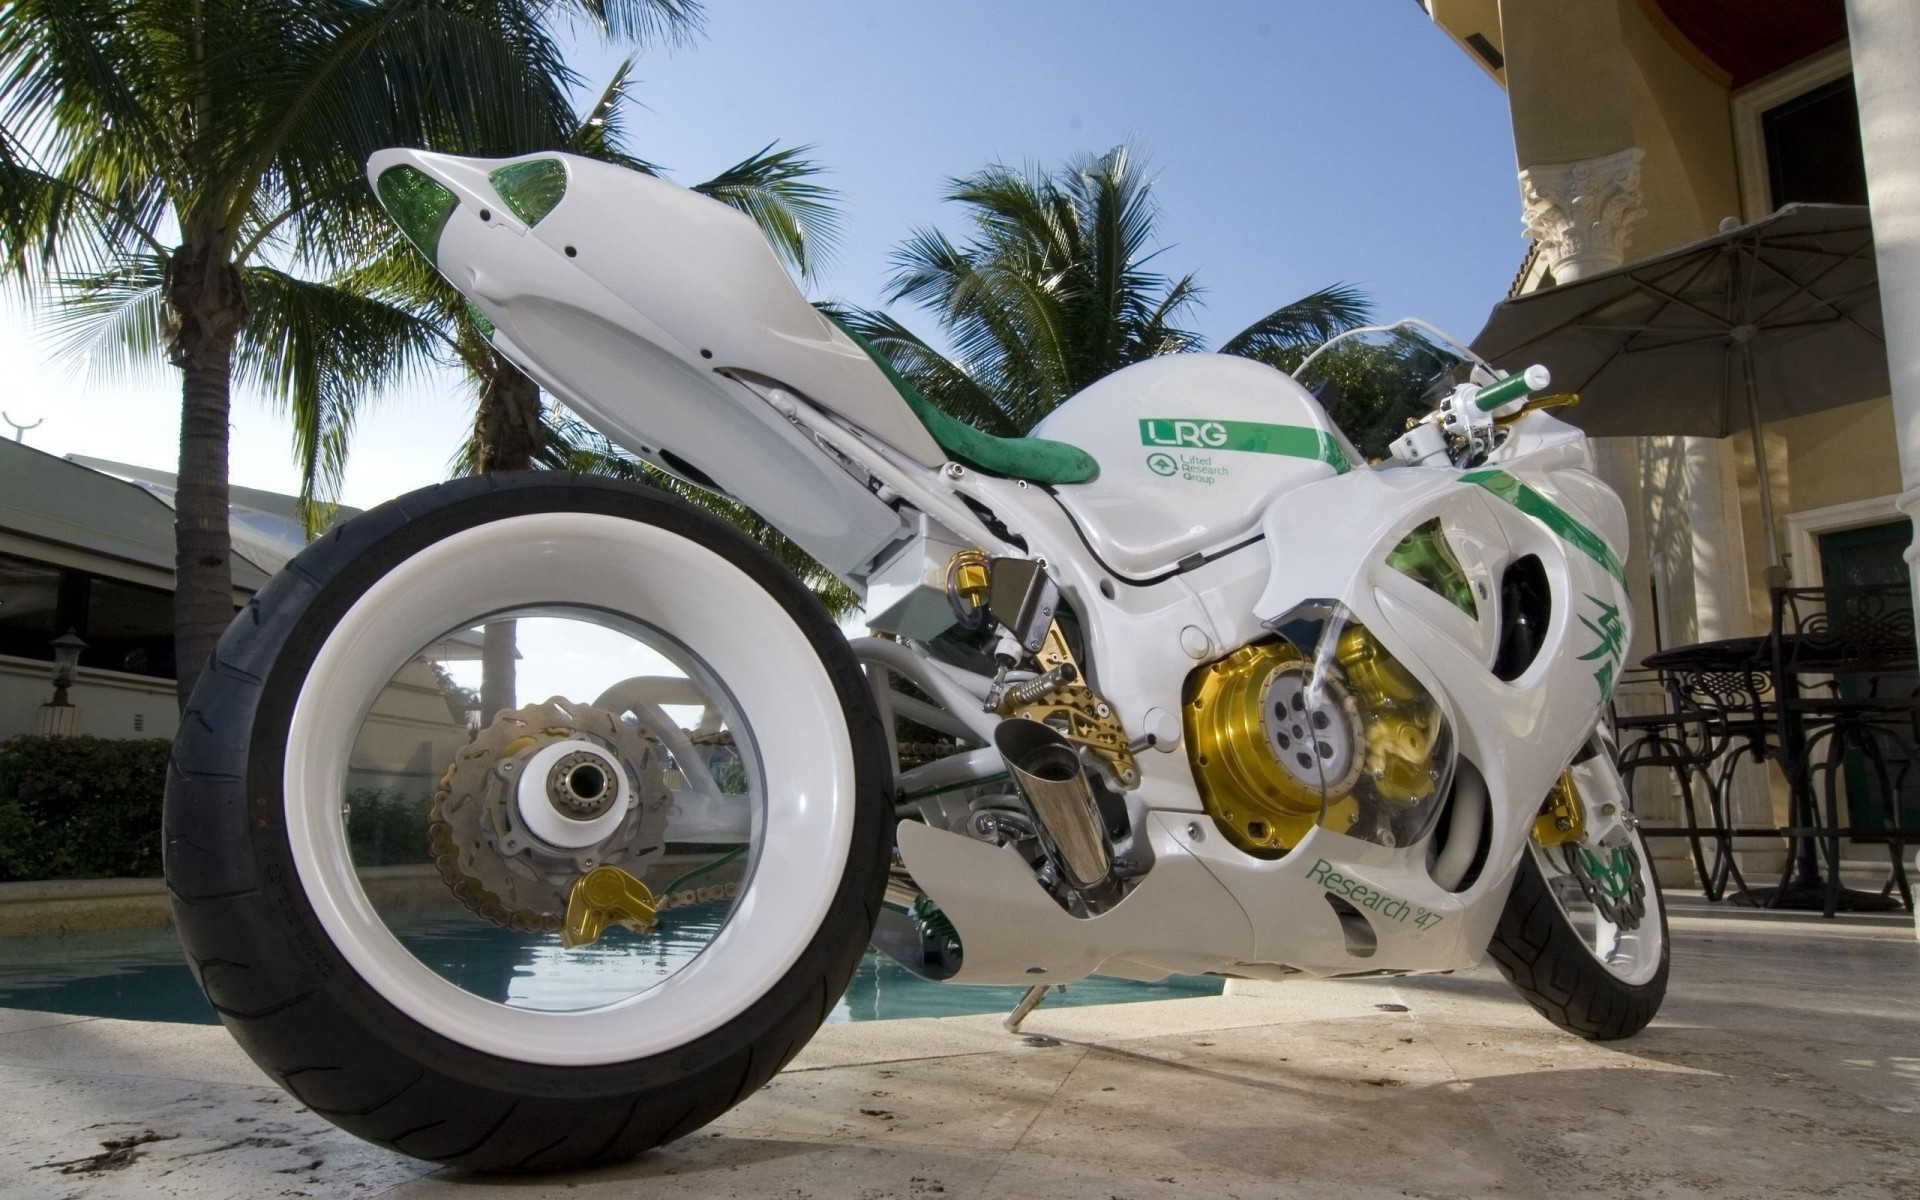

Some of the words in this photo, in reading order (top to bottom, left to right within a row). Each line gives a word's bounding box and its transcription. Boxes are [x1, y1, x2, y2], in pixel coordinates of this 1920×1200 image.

[1148, 421, 1228, 448] LRG
[1180, 453, 1212, 465] Lifted
[1181, 464, 1229, 475] Research
[1183, 472, 1215, 485] Group
[1305, 858, 1411, 922] Research
